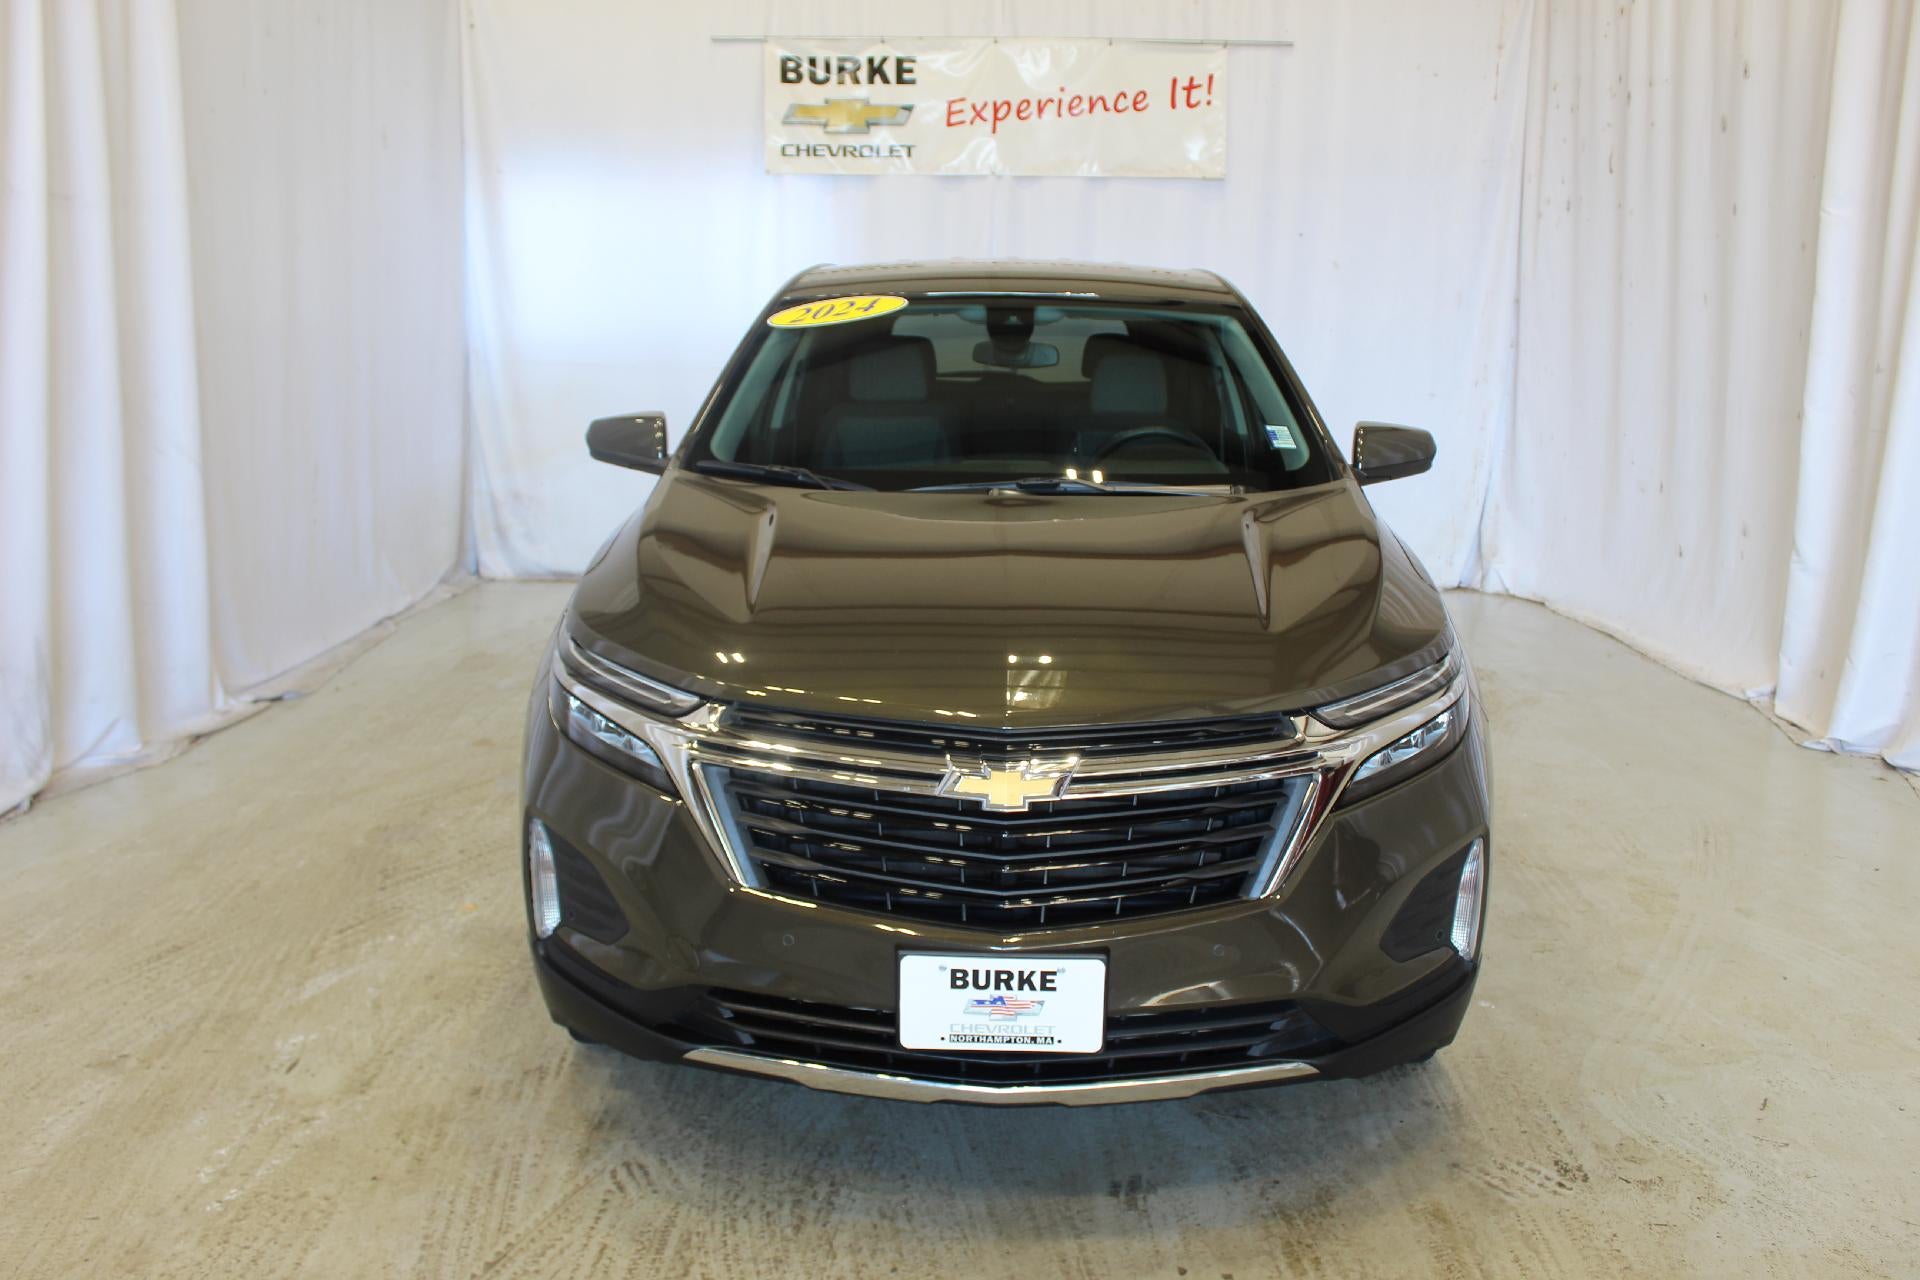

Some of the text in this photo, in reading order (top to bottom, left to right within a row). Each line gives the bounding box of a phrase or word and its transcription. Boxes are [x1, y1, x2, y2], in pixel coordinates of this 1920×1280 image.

[780, 55, 917, 85] BURKE
[945, 73, 1215, 134] Experience It!
[780, 144, 917, 158] CHEVROLET
[789, 297, 881, 324] 2024
[950, 969, 1057, 992] BURKE
[950, 1024, 1057, 1035] CHEVROLET
[1036, 1036, 1053, 1045] MA
